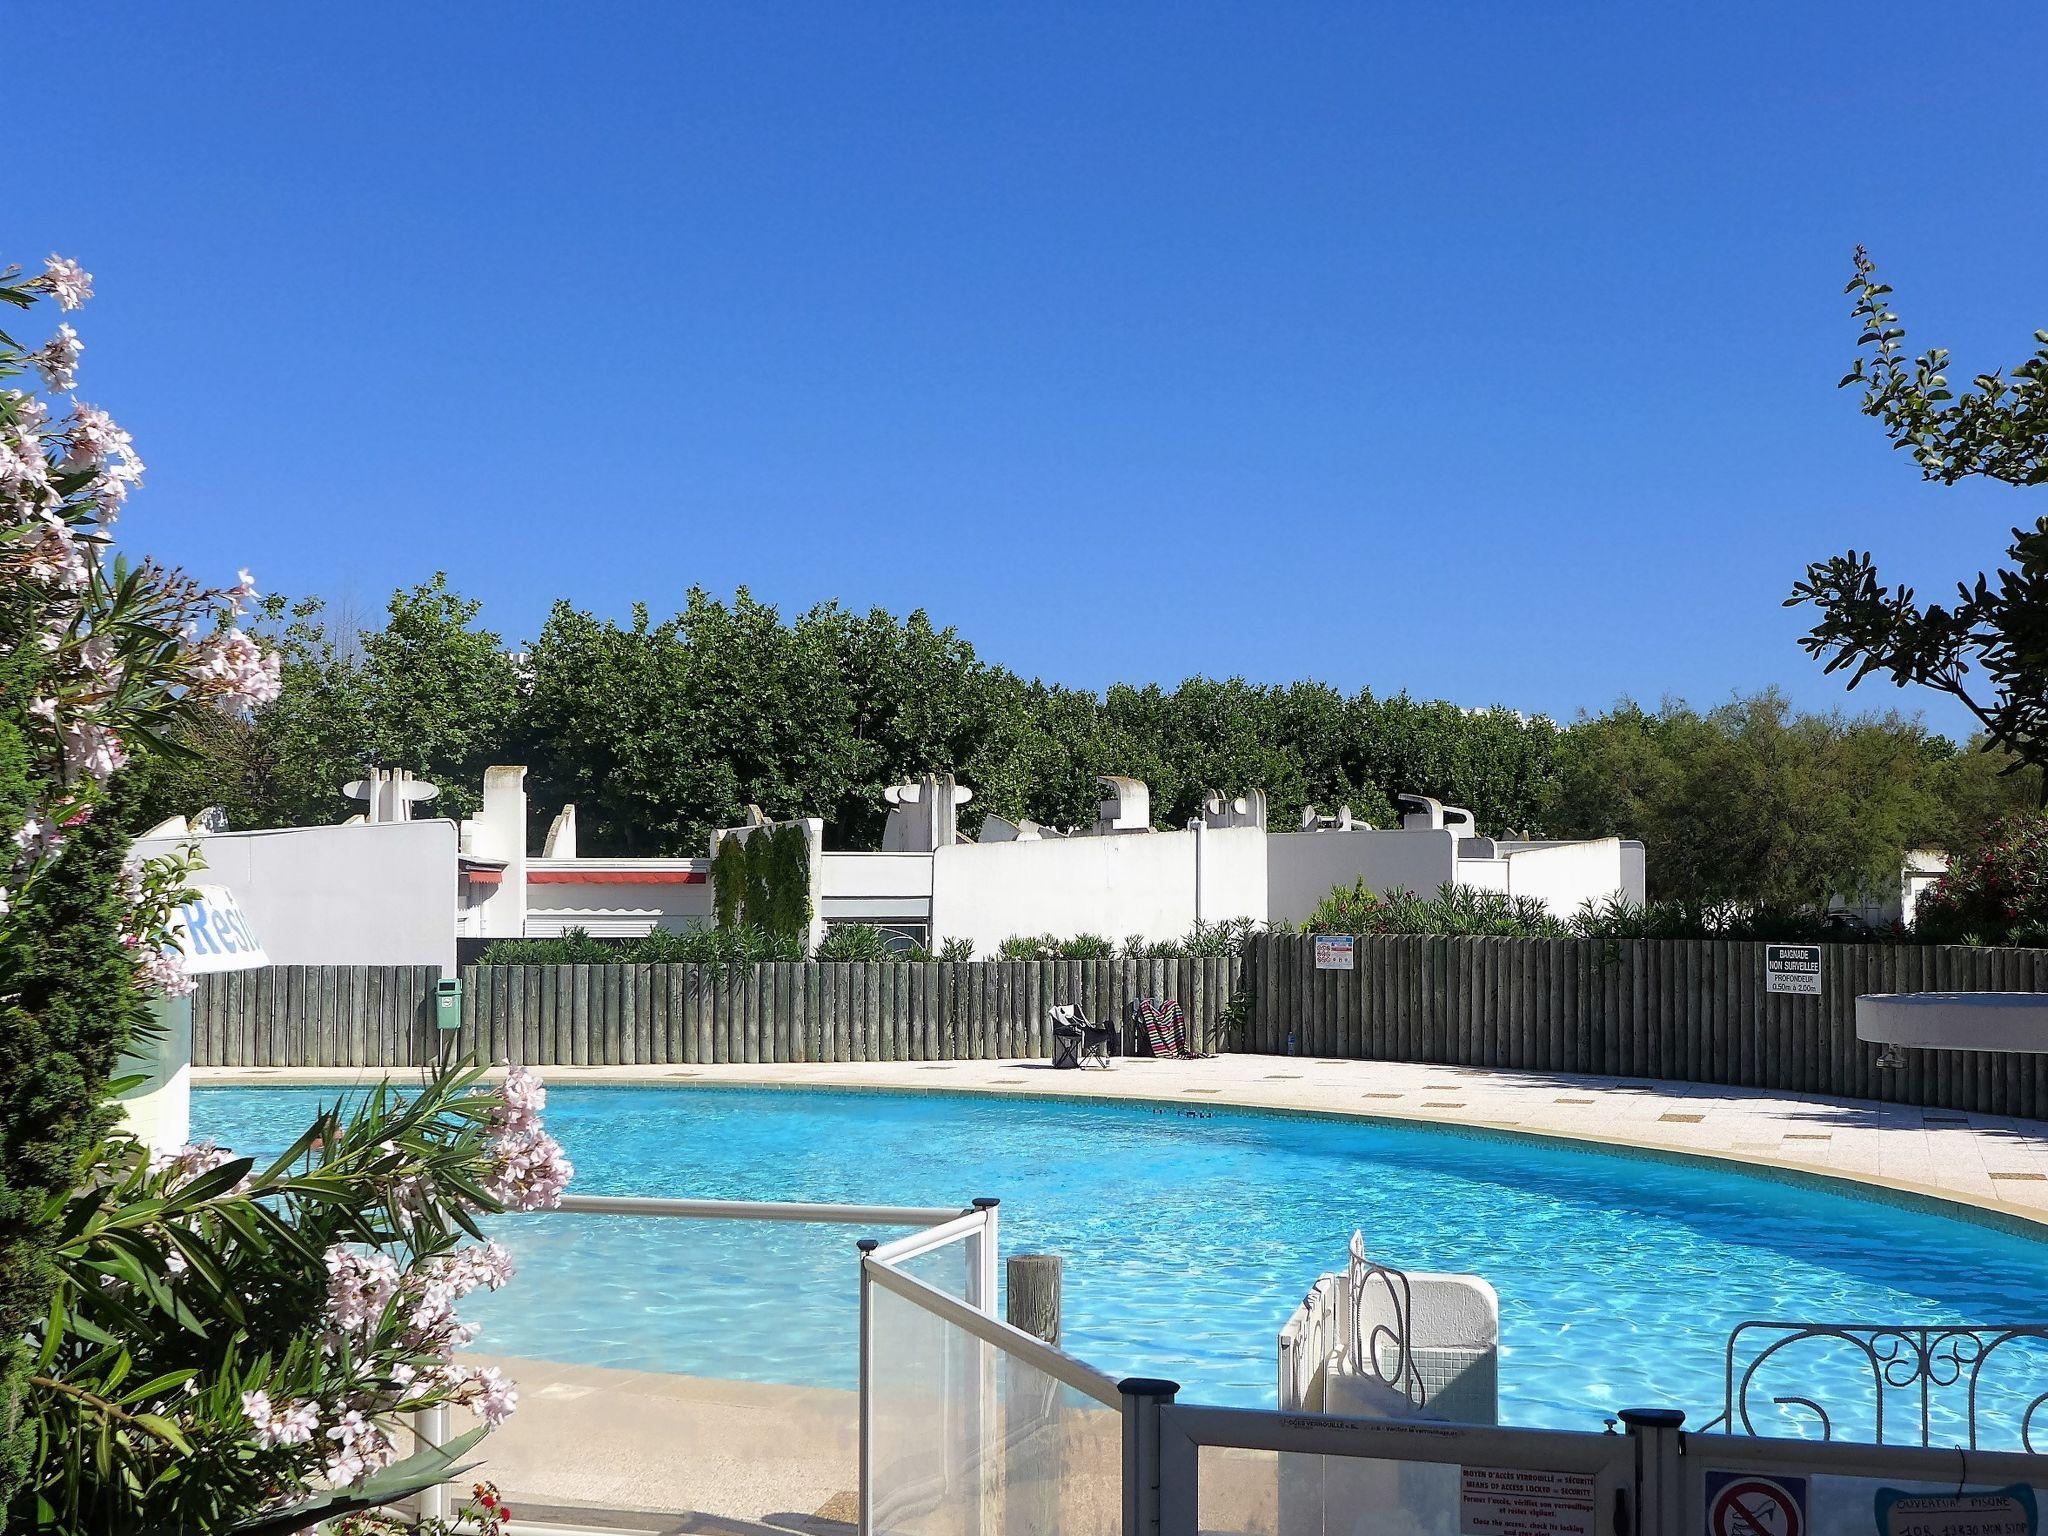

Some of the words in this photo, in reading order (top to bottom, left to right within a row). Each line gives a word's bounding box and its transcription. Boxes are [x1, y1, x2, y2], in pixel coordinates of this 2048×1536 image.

[1779, 949, 1809, 960] BAIGNADE
[1769, 960, 1783, 970] NON
[1774, 974, 1814, 983] PROFONDEUR
[1463, 1469, 1487, 1478] MOYEN
[1488, 1471, 1514, 1480] D'ACCÈS
[1466, 1480, 1489, 1489] MEANS
[1501, 1484, 1524, 1492] ACCESS
[1526, 1485, 1551, 1493] LOCKED
[1561, 1487, 1591, 1497] SECURITY
[1553, 1502, 1594, 1512] verrouillage
[1473, 1517, 1490, 1526] Close
[1529, 1522, 1547, 1530] check
[1559, 1524, 1585, 1534] locking
